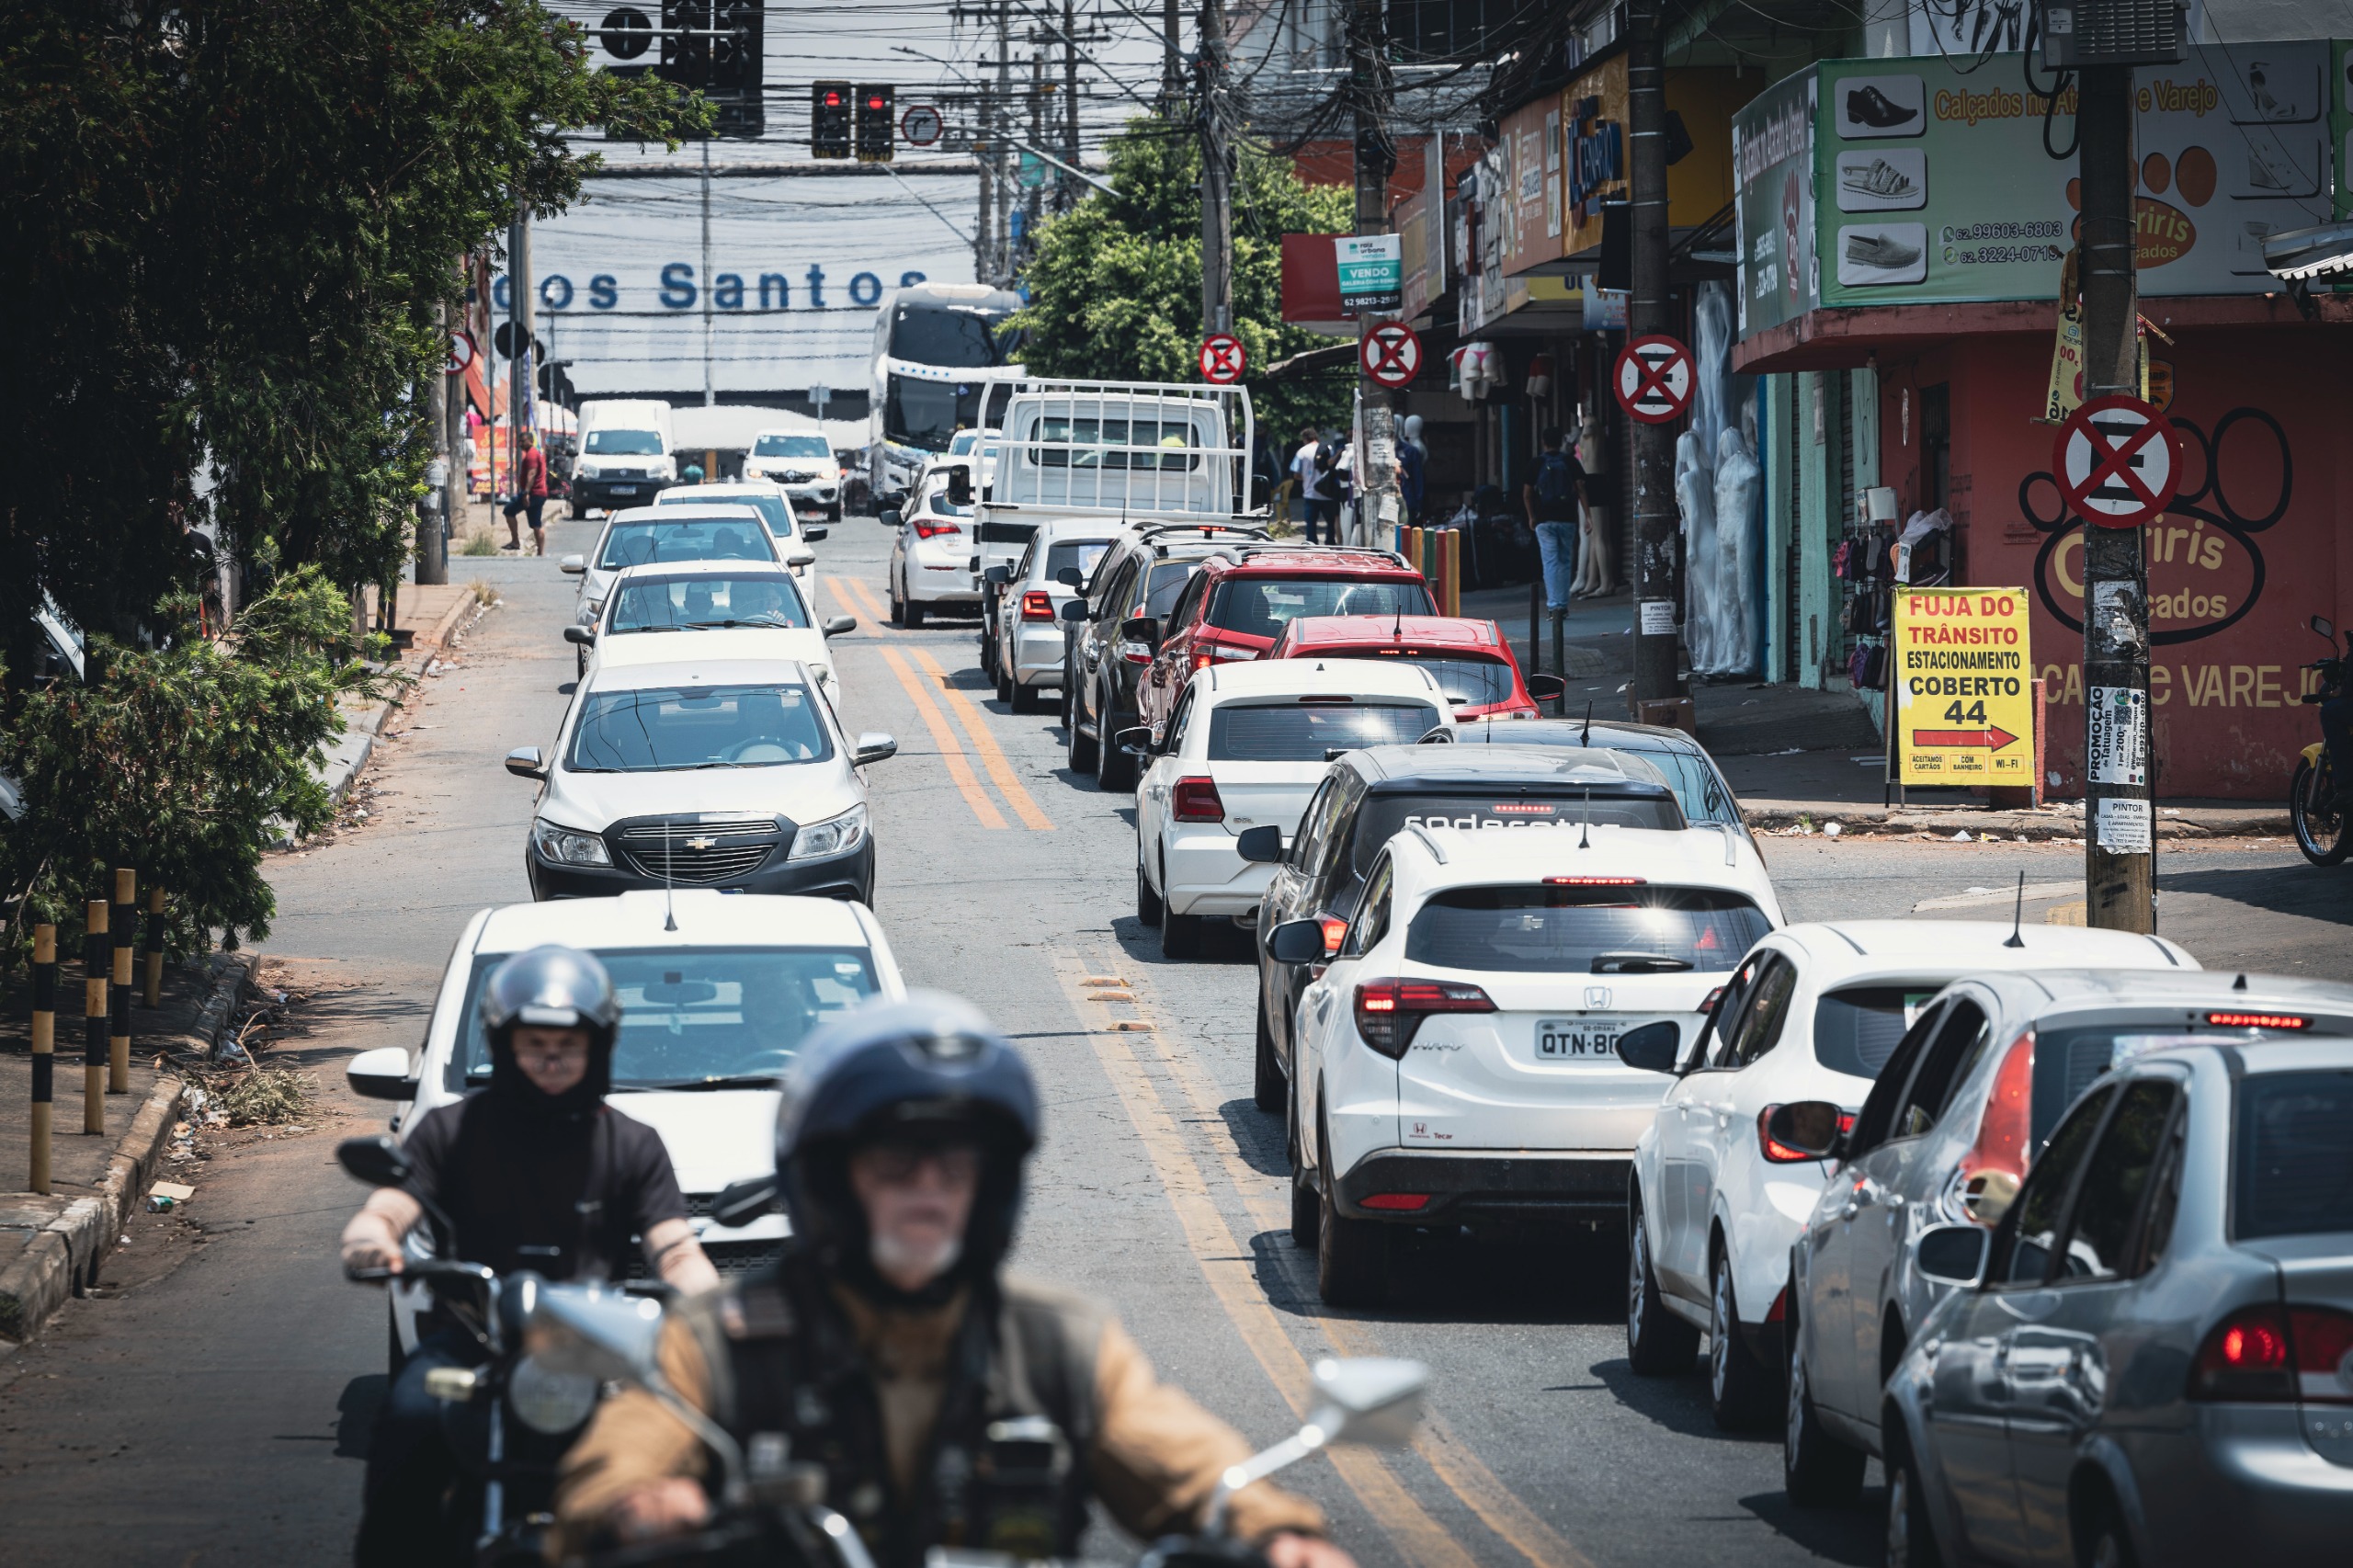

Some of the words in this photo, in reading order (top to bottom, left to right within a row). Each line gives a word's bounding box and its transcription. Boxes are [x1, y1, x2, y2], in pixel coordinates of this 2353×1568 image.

[1935, 87, 2023, 126] Calçados
[2137, 87, 2152, 112] e
[2153, 79, 2218, 118] Varejo
[2136, 205, 2189, 243] riris
[1349, 267, 1390, 278] VENDO
[1345, 298, 1354, 307] 62
[1910, 596, 1972, 617] FUJA
[1981, 596, 2015, 617] DO
[1908, 622, 2018, 645] TRÂNSITO
[1907, 651, 2020, 670] ESTACIONAMENTO
[1909, 676, 2020, 697] COBERTO
[1944, 699, 1987, 725] 44
[2090, 687, 2105, 780] PROMOÇÃO
[2101, 710, 2112, 759] Tatuagem
[1961, 756, 1974, 764] COM
[2103, 759, 2109, 767] de
[2112, 803, 2143, 812] PINTOR
[1434, 1131, 1453, 1140] Tecar
